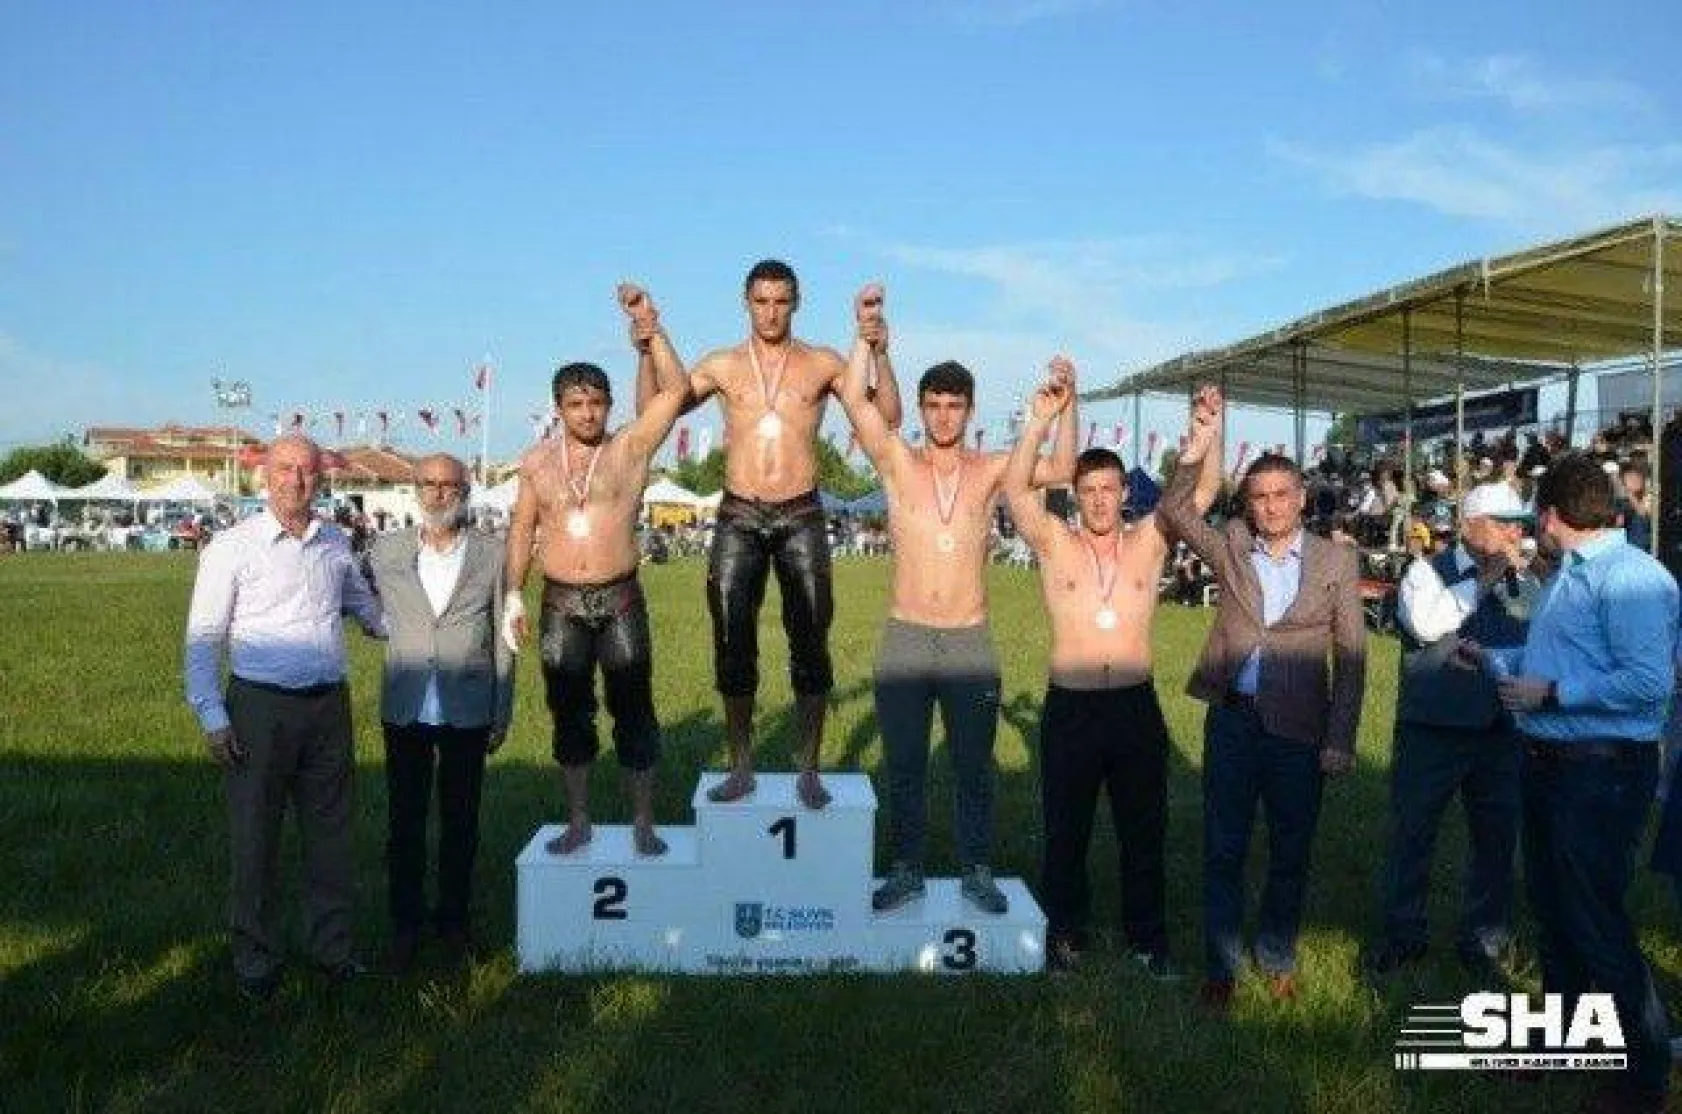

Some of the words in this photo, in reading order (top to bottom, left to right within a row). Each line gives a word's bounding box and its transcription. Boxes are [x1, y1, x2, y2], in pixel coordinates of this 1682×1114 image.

[767, 816, 796, 860] 1
[593, 877, 628, 920] 2
[943, 929, 976, 970] 3
